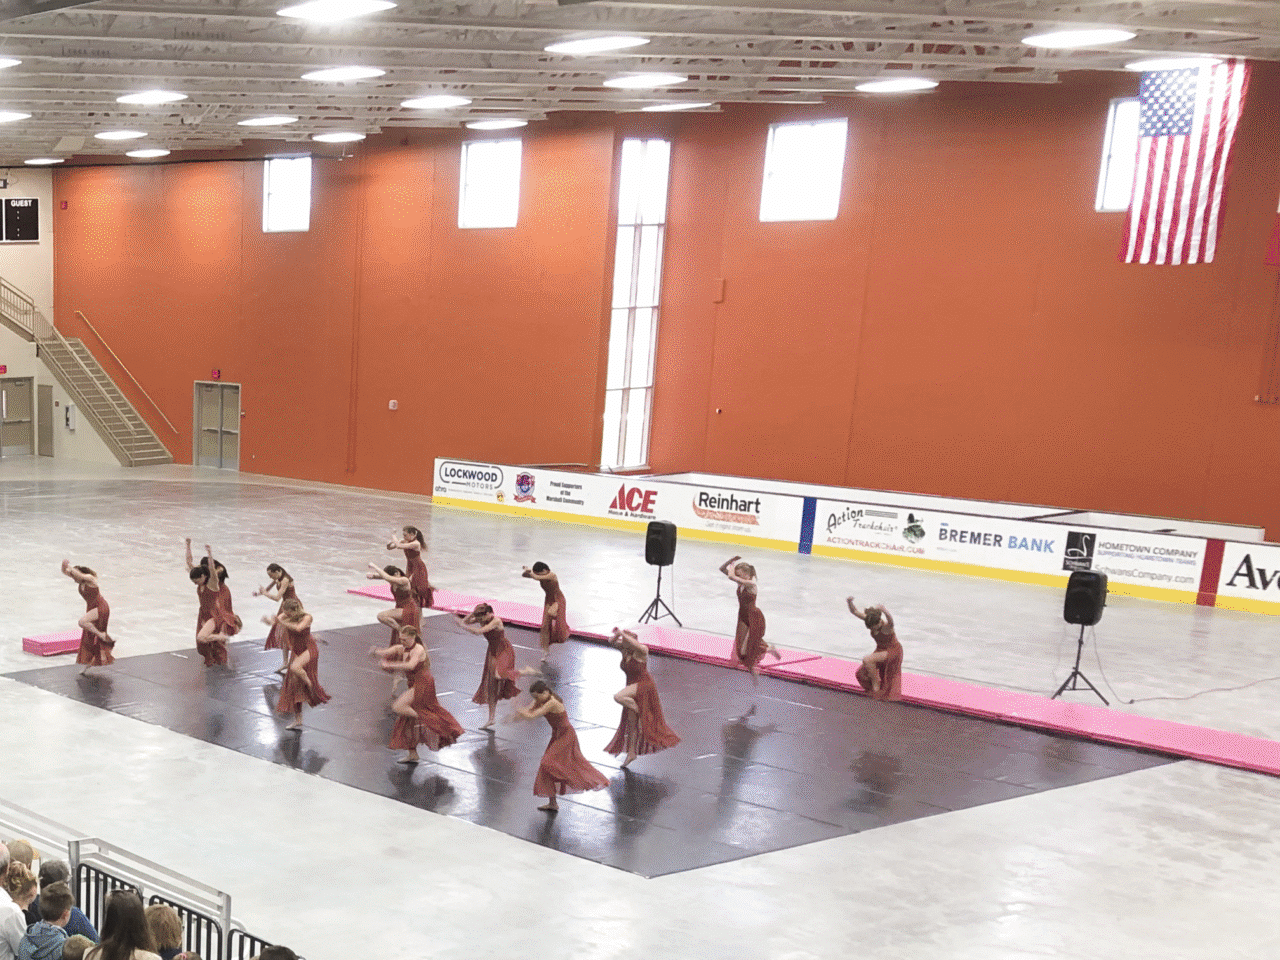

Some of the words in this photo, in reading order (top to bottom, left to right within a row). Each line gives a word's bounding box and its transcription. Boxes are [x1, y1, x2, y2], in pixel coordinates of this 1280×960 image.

[444, 467, 497, 482] LOCKWOOD
[466, 481, 493, 490] MOTORS
[609, 483, 658, 513] ACE
[698, 492, 761, 513] Reinhart
[826, 507, 863, 533] Action
[939, 528, 1003, 547] BREMER
[1008, 535, 1055, 553] BANK
[1098, 542, 1151, 553] HOMETOWN
[1153, 547, 1198, 558] COMPANY
[1095, 565, 1195, 583] SchwansCompany.com
[1225, 553, 1280, 591] Av
